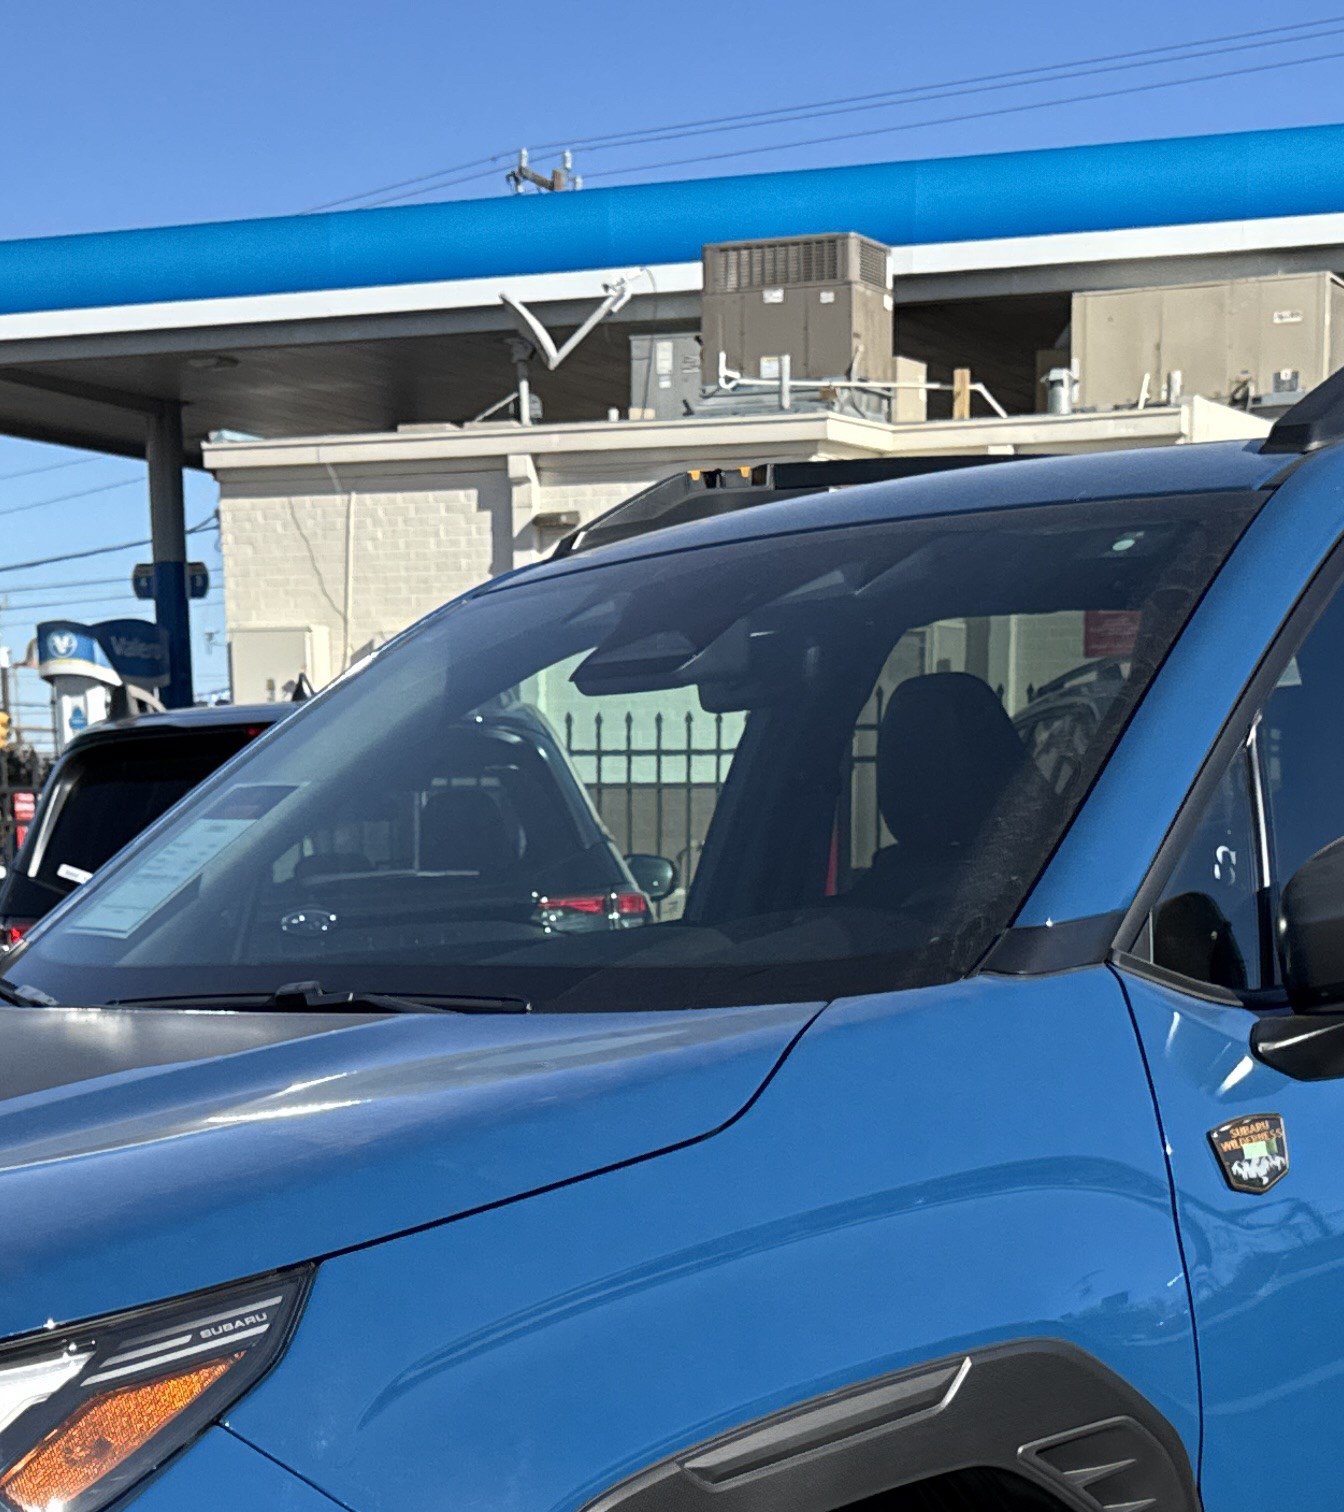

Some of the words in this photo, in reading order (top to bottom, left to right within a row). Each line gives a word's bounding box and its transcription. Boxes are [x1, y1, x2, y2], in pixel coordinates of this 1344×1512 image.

[1220, 1127, 1283, 1153] WILDERNESS
[1230, 1120, 1269, 1140] SUBARU
[199, 1312, 268, 1339] SUBARU
